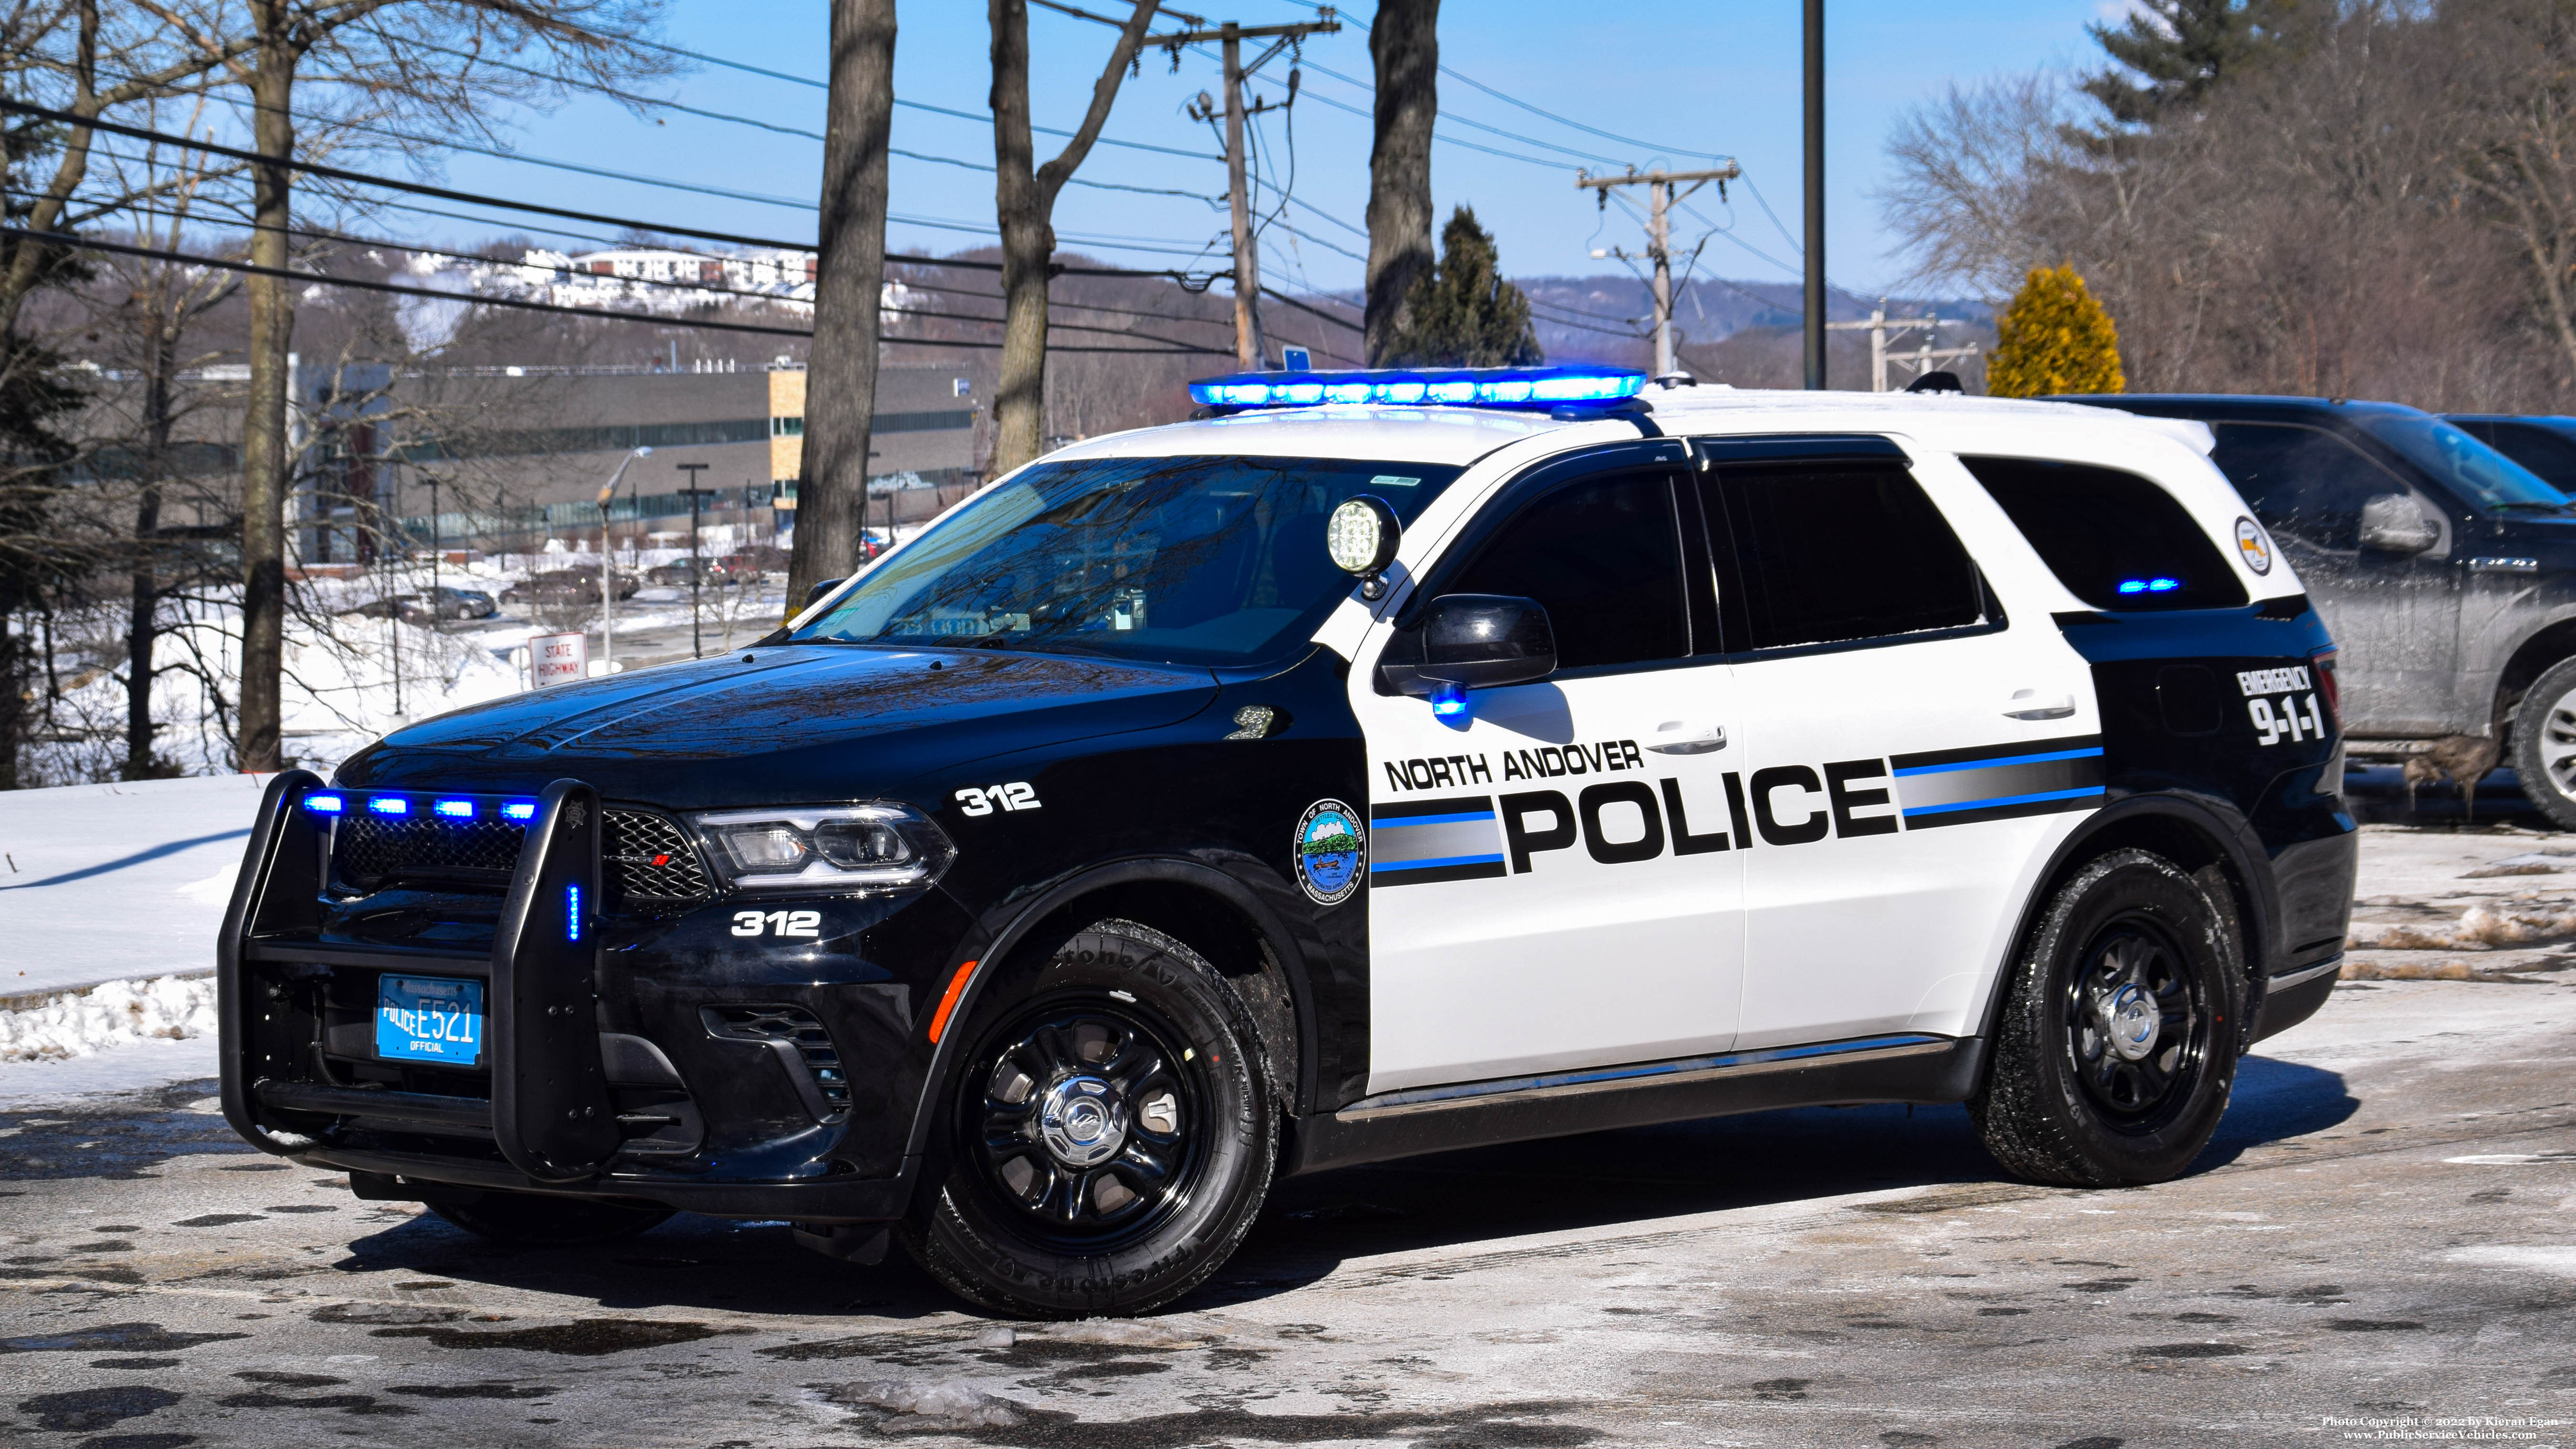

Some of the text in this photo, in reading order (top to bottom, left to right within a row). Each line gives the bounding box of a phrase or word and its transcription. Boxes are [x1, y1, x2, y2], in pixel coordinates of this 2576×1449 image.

[545, 644, 572, 658] STATE
[538, 662, 579, 677] HIGHWAY
[2236, 666, 2312, 696] EMERGENCY
[2248, 693, 2325, 746] 9-1-1
[1384, 739, 1644, 792] NORTH ANDOVER
[955, 781, 1042, 817] 312
[1297, 802, 1363, 844] TOWN OF NORTH ANDOVER
[1315, 813, 1333, 824] SETTLED
[1499, 758, 1899, 874] POLICE
[1307, 881, 1354, 901] MASSACHUSETTS
[1308, 869, 1332, 890] INCORPORATED
[1332, 881, 1343, 889] APRIL
[731, 910, 821, 937] 312
[402, 980, 458, 996] Massachusetts
[383, 997, 474, 1043] POLICE E521
[410, 1041, 444, 1053] OFFICIAL
